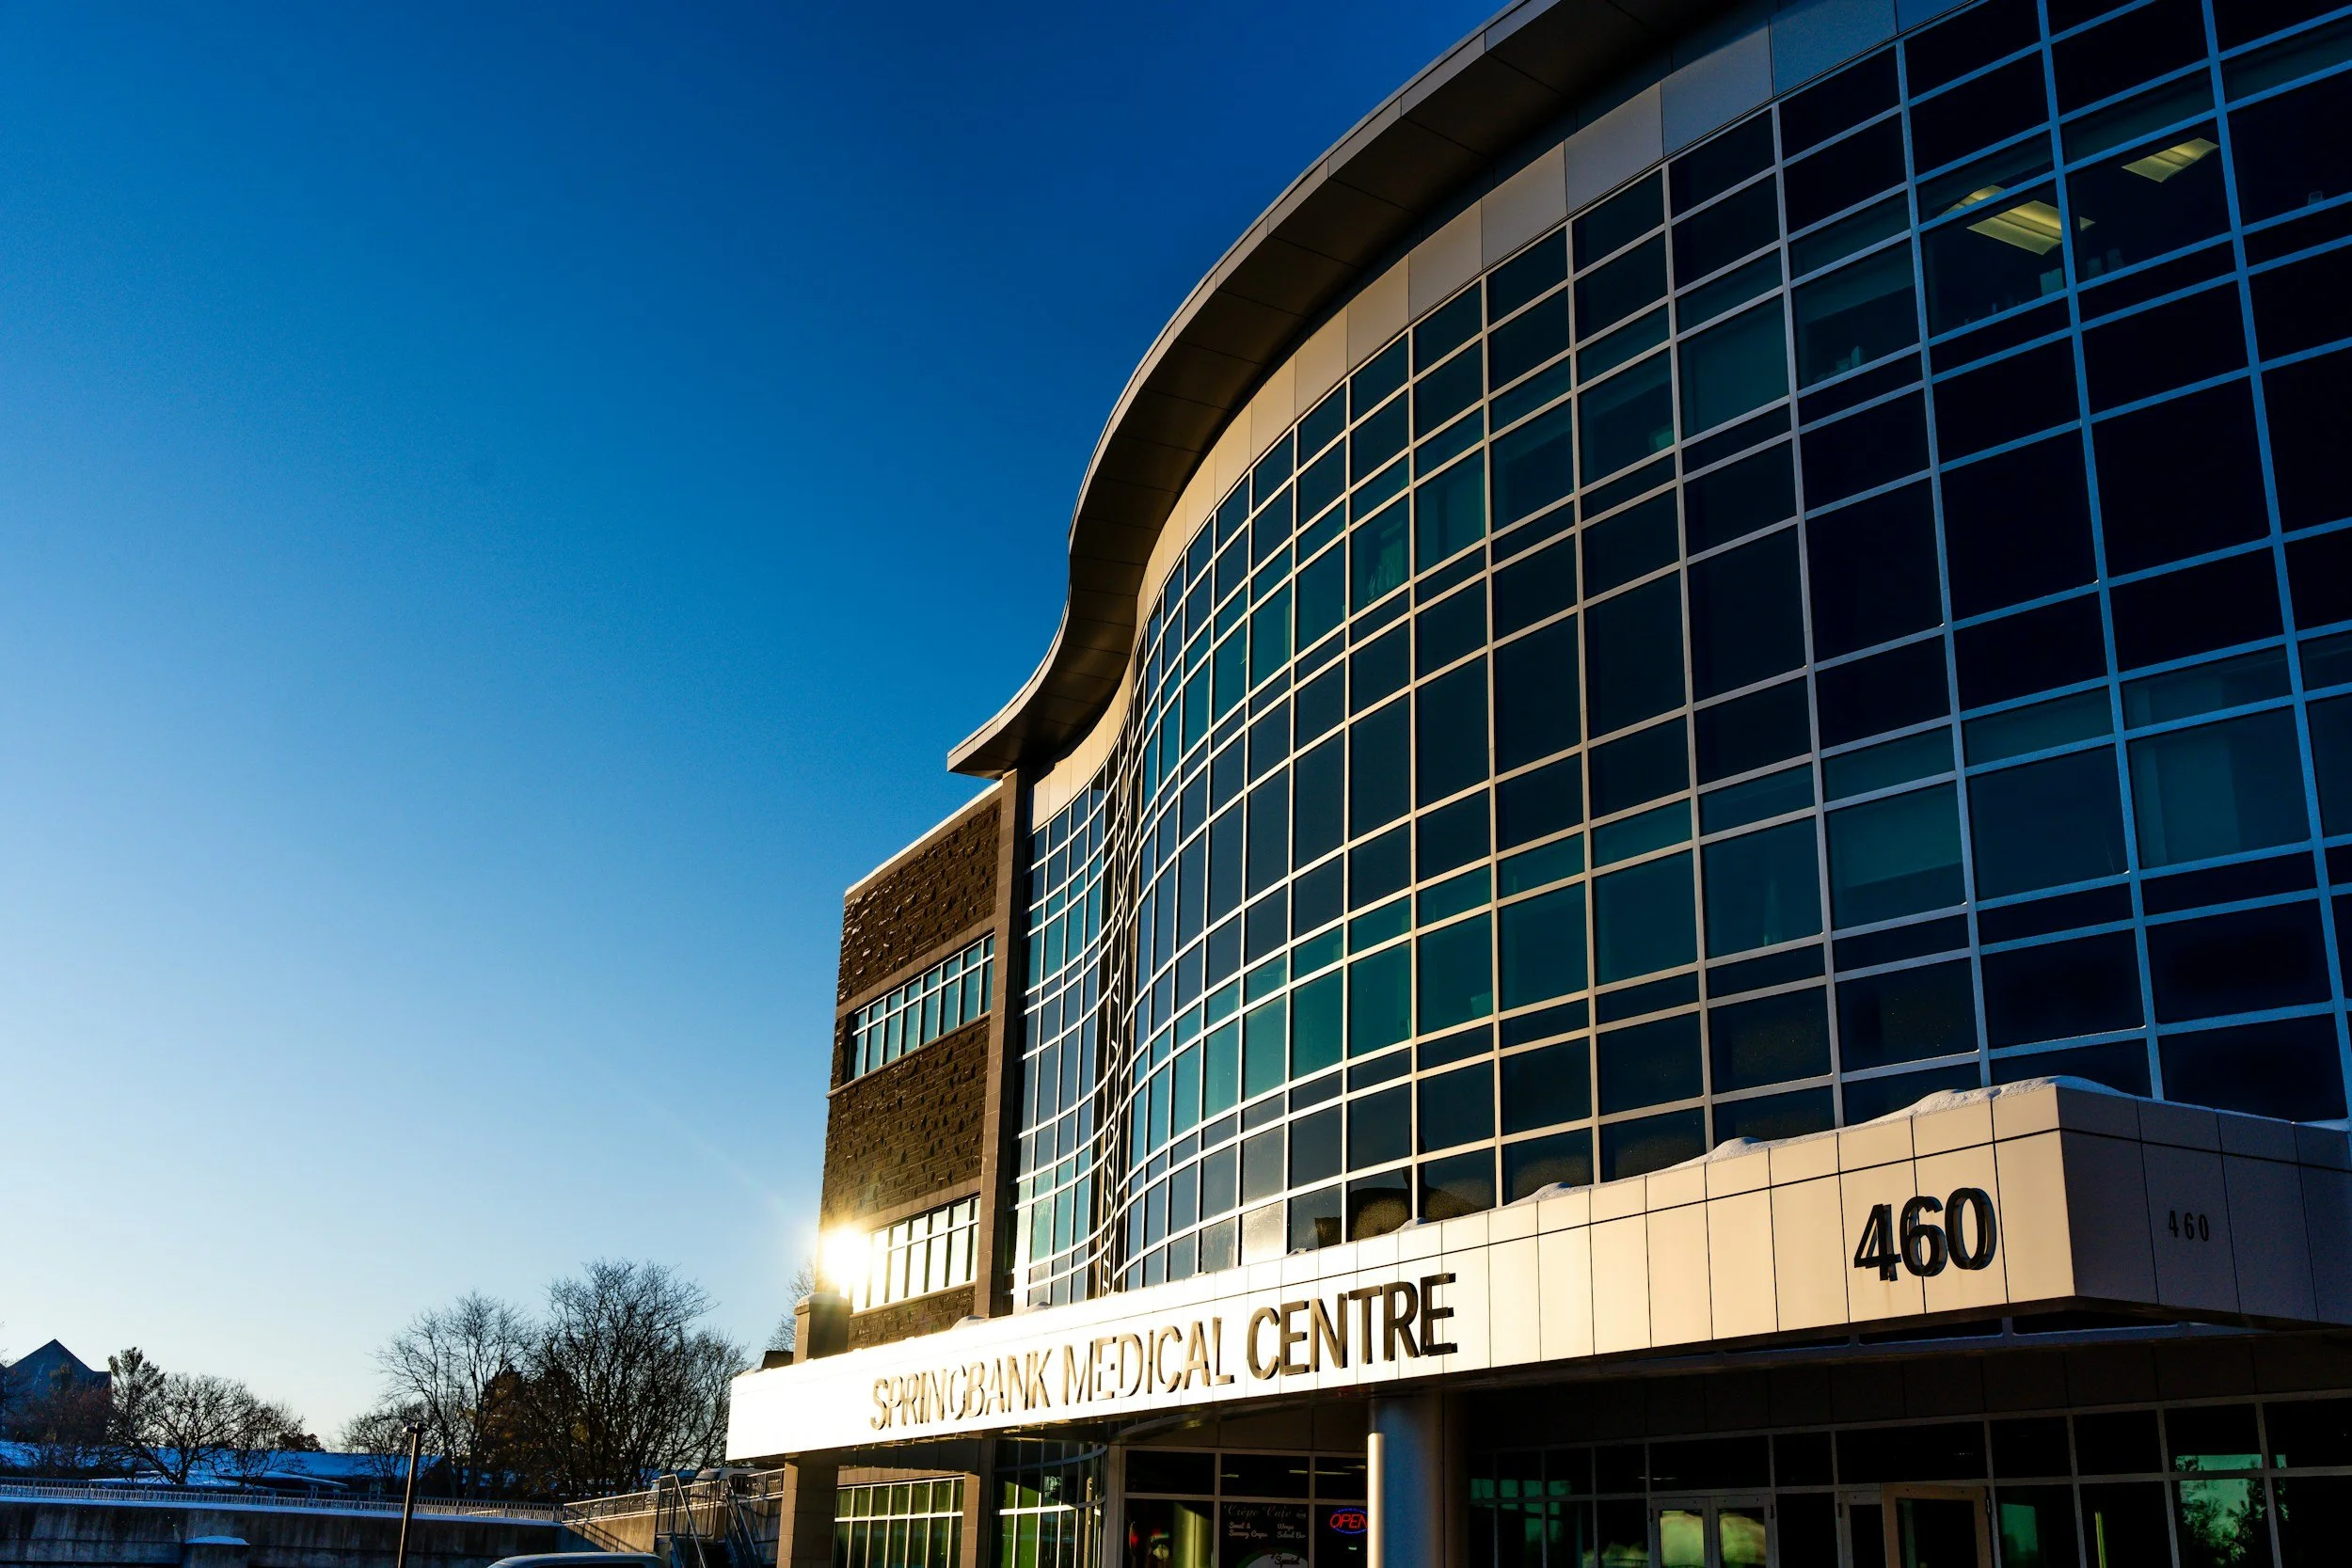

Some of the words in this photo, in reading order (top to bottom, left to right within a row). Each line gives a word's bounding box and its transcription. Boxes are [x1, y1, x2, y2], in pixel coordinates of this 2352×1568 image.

[1853, 1187, 1997, 1282] 460
[2168, 1210, 2210, 1243] 460
[870, 1348, 1053, 1430] SPRINGBANK
[1061, 1317, 1235, 1406] MEDICAL
[1247, 1273, 1458, 1381] CENTRE
[1329, 1513, 1368, 1528] OPEN
